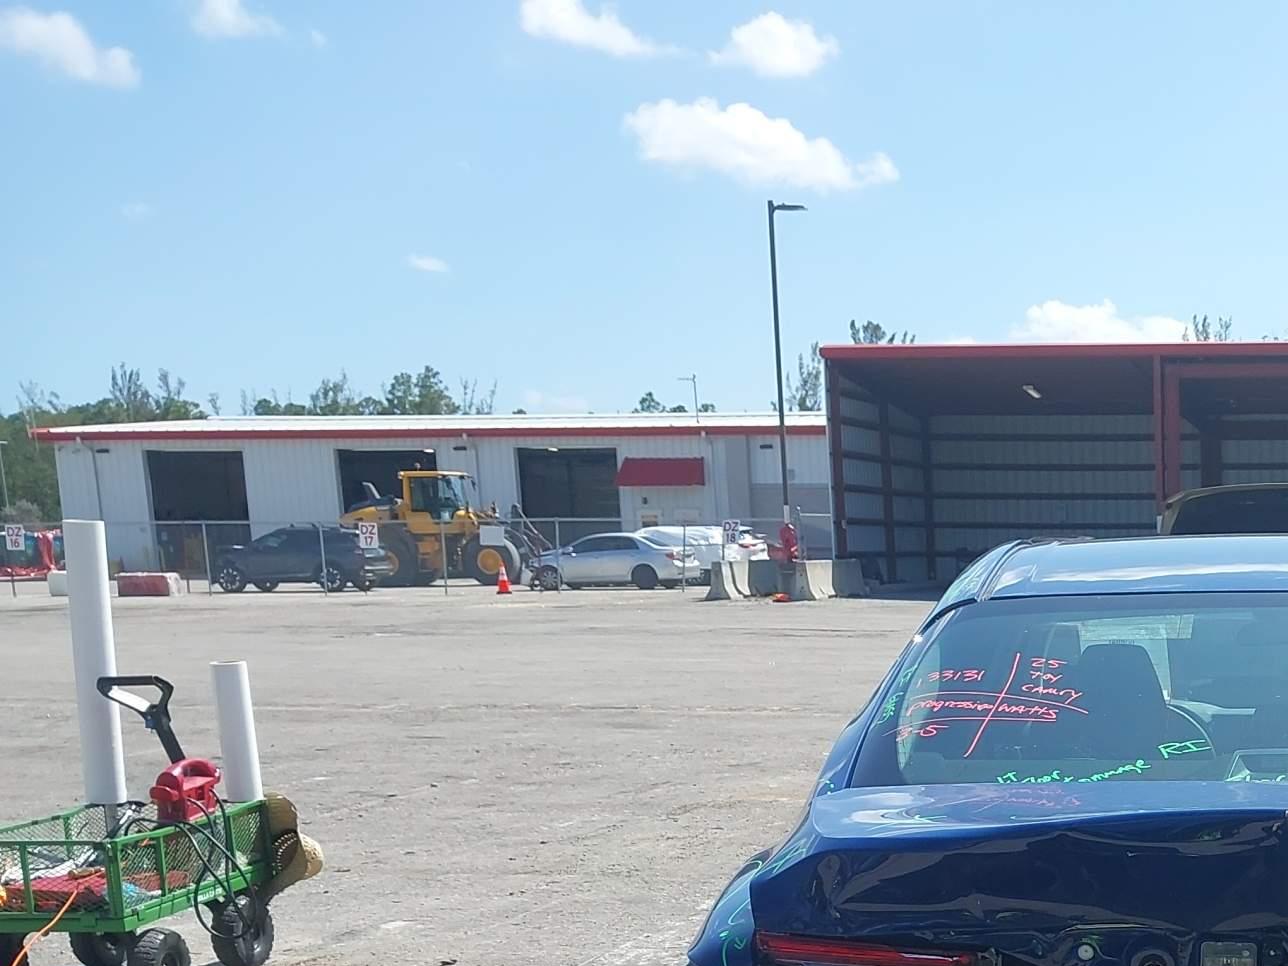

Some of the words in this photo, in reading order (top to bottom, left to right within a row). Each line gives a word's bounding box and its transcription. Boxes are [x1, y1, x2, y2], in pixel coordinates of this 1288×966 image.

[360, 525, 376, 535] DZ
[723, 521, 739, 531] DZ
[7, 526, 22, 537] DZ
[364, 536, 374, 546] 17
[726, 533, 736, 542] 18
[10, 538, 20, 548] 16
[1031, 657, 1068, 668] 25
